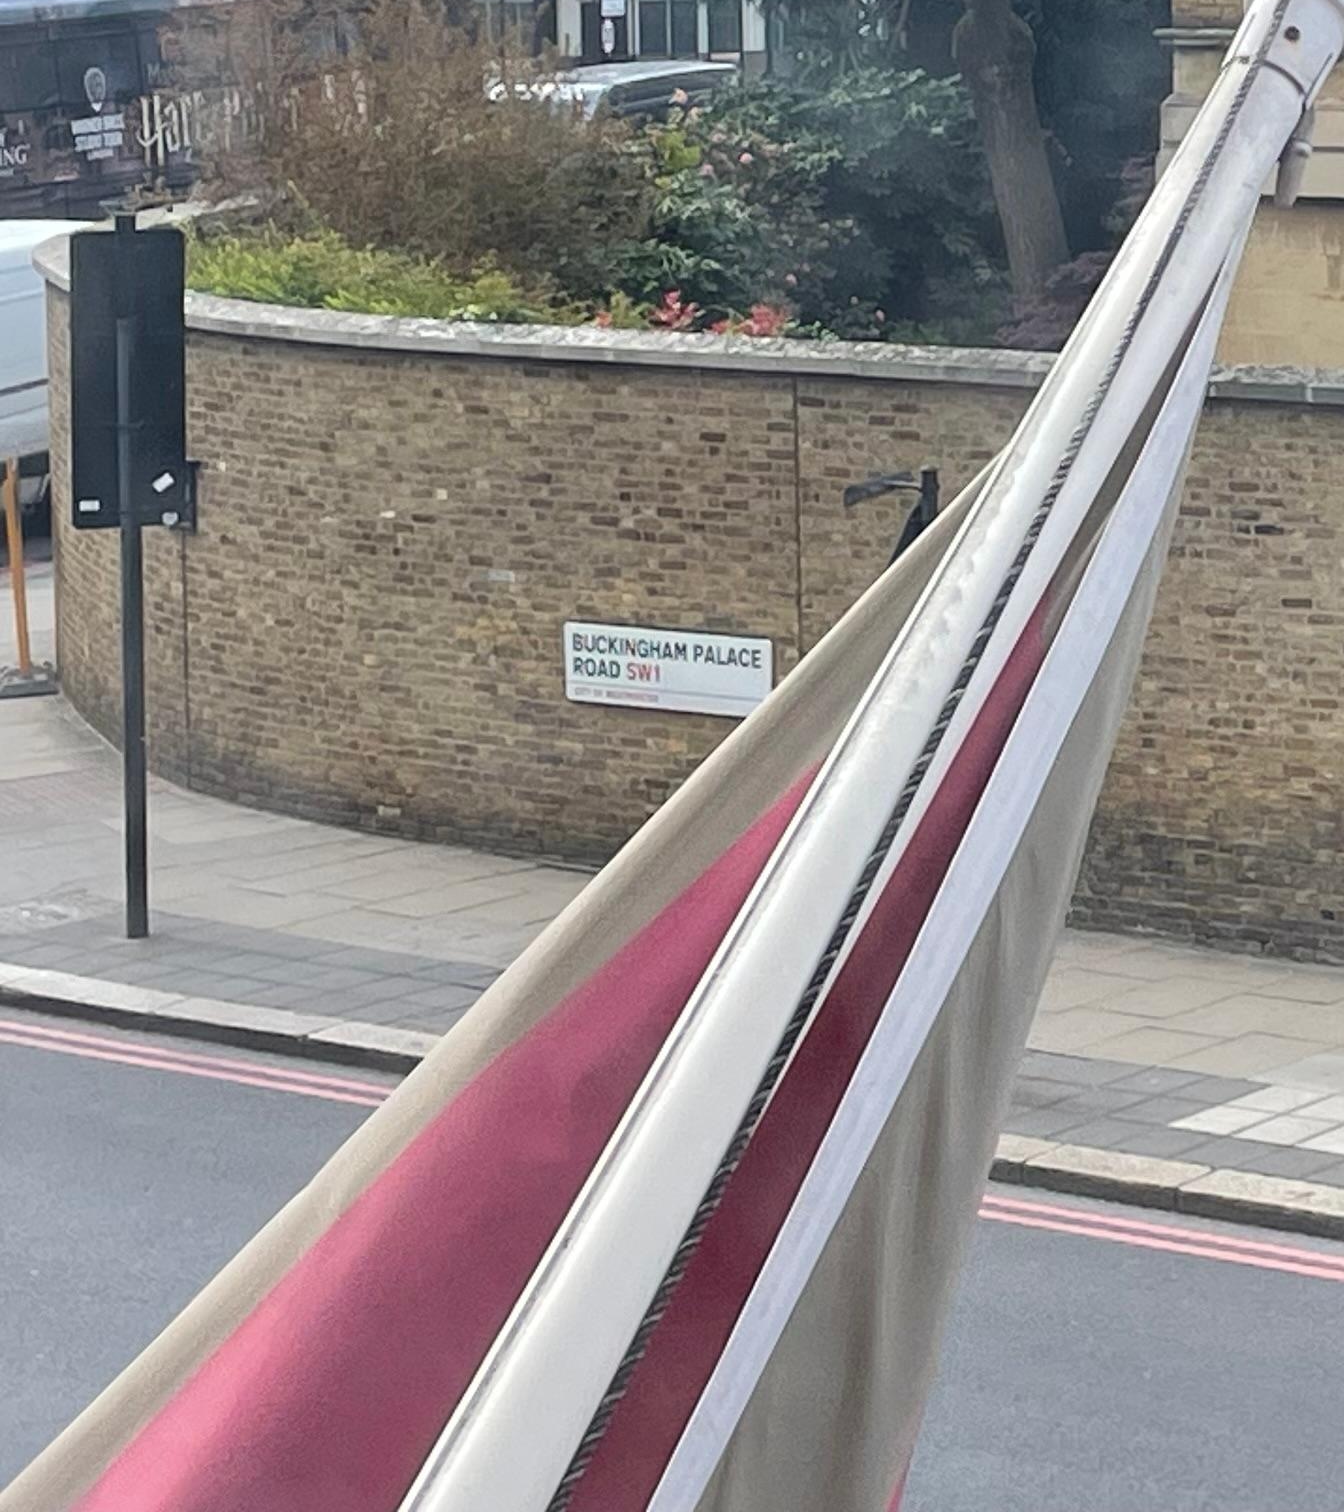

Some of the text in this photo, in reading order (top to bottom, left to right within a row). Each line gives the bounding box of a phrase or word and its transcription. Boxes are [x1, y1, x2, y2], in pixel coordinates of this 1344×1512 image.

[572, 633, 761, 669] BUCKINGHAM PALACE
[573, 656, 661, 682] ROAD SW1
